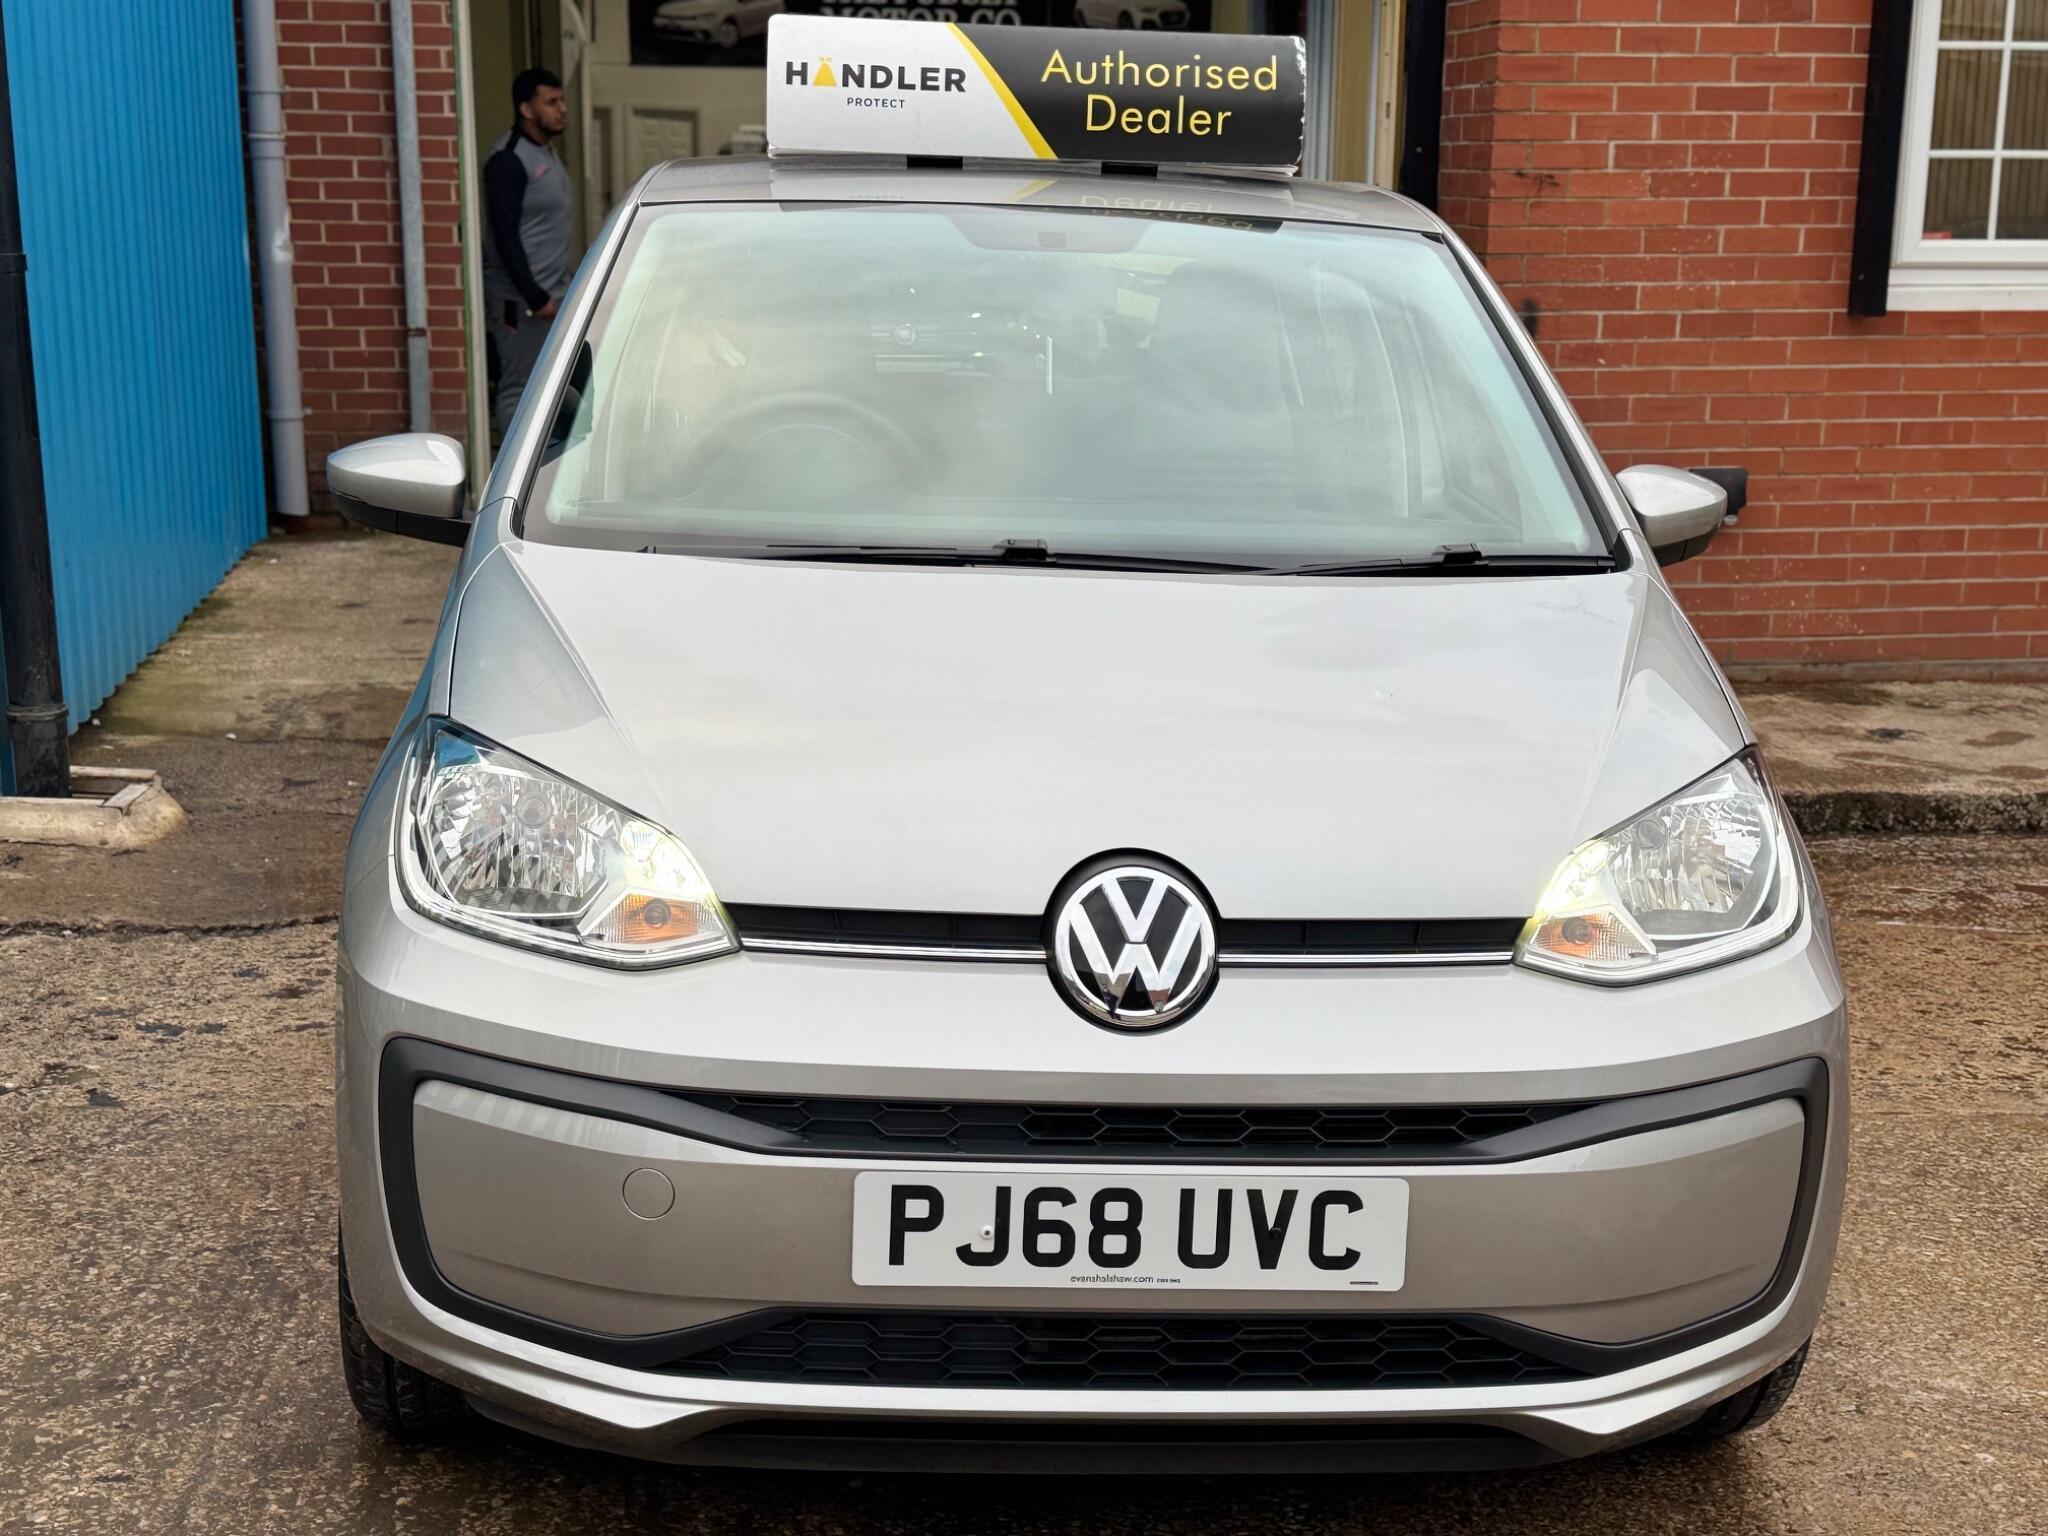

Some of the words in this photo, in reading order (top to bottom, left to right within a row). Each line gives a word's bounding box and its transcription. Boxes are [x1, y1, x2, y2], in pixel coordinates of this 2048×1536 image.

[1040, 48, 1278, 92] Authorised
[846, 97, 906, 109] PROTECT
[1086, 94, 1232, 136] Dealer
[888, 1184, 1143, 1269] PJ68
[1177, 1187, 1364, 1271] UVC
